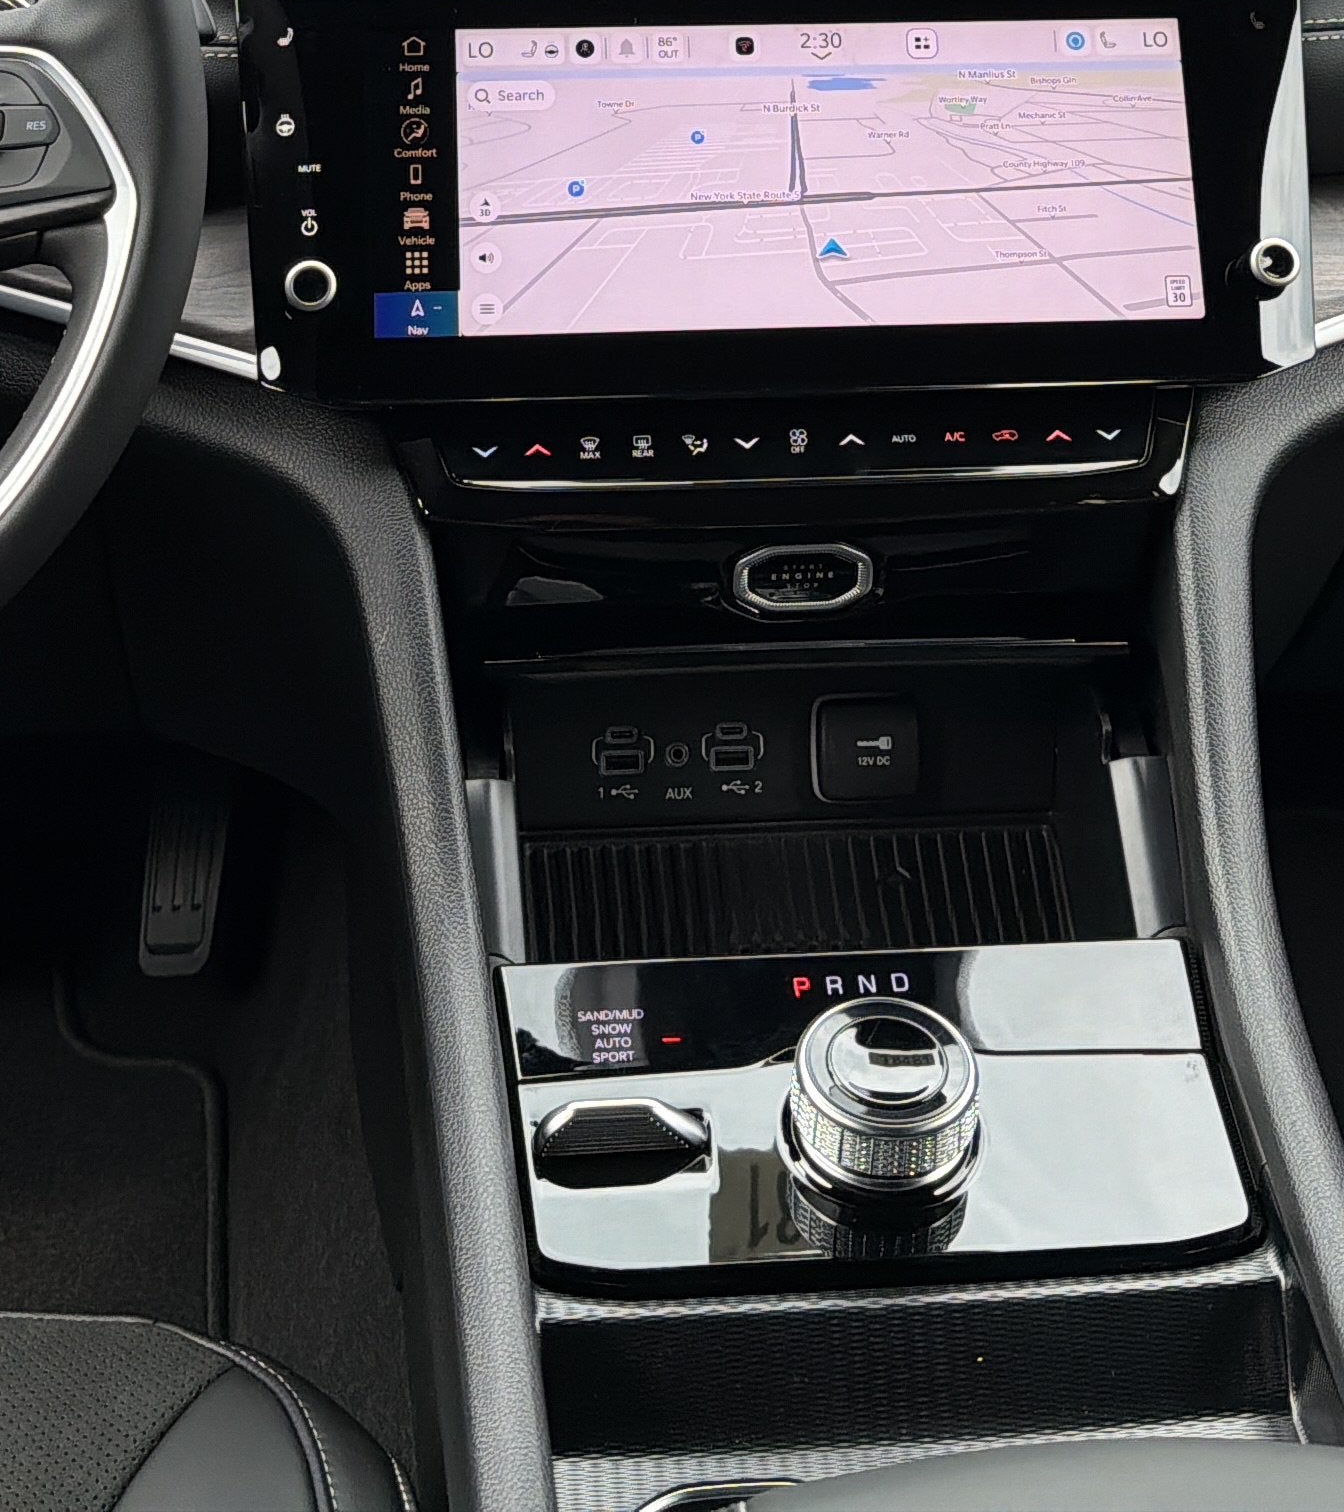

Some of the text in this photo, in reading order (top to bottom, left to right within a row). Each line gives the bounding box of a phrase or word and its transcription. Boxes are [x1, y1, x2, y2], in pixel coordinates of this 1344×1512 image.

[658, 36, 678, 48] 86°
[800, 32, 843, 50] 2:30
[1143, 31, 1168, 48] LO
[468, 41, 494, 59] LO
[658, 49, 679, 59] OUT
[399, 63, 430, 73] Home
[1030, 77, 1061, 86] Bishops
[497, 86, 545, 104] Search
[970, 96, 987, 104] Way
[597, 100, 623, 108] Towne
[771, 104, 807, 112] Burdick
[810, 104, 820, 112] St
[399, 105, 430, 115] Media
[1018, 111, 1056, 119] Mechanic
[26, 120, 47, 131] RES
[980, 122, 999, 130] Pratt
[867, 130, 909, 139] Warner Rd
[394, 148, 437, 158] Comfort
[298, 163, 322, 173] MUTE
[1002, 160, 1032, 169] County
[1033, 160, 1069, 169] Highway
[400, 191, 433, 201] Phone
[690, 192, 706, 201] New
[709, 192, 733, 200] York
[737, 191, 762, 200] State
[764, 191, 792, 199] Route
[301, 208, 318, 217] VOL
[479, 208, 491, 217] 3D
[1037, 205, 1057, 213] Fitch
[398, 236, 435, 246] Vehicle
[995, 249, 1048, 259] Thompson St
[404, 281, 431, 292] Apps
[1172, 292, 1186, 303] 30
[407, 325, 429, 335] Nav
[891, 434, 916, 443] AUTO
[944, 431, 966, 442] A/C
[632, 449, 654, 458] REAR
[790, 445, 806, 454] OFF
[580, 451, 601, 460] MAX
[771, 571, 834, 581] ENGINE
[858, 755, 891, 766] 12V DC
[754, 781, 763, 793] 2
[665, 788, 693, 800] AUX
[793, 972, 909, 998] P R N D
[577, 1008, 644, 1021] SAND/MUD
[591, 1023, 633, 1035] SNOW
[594, 1036, 632, 1049] AUTO
[592, 1050, 634, 1064] SPORT
